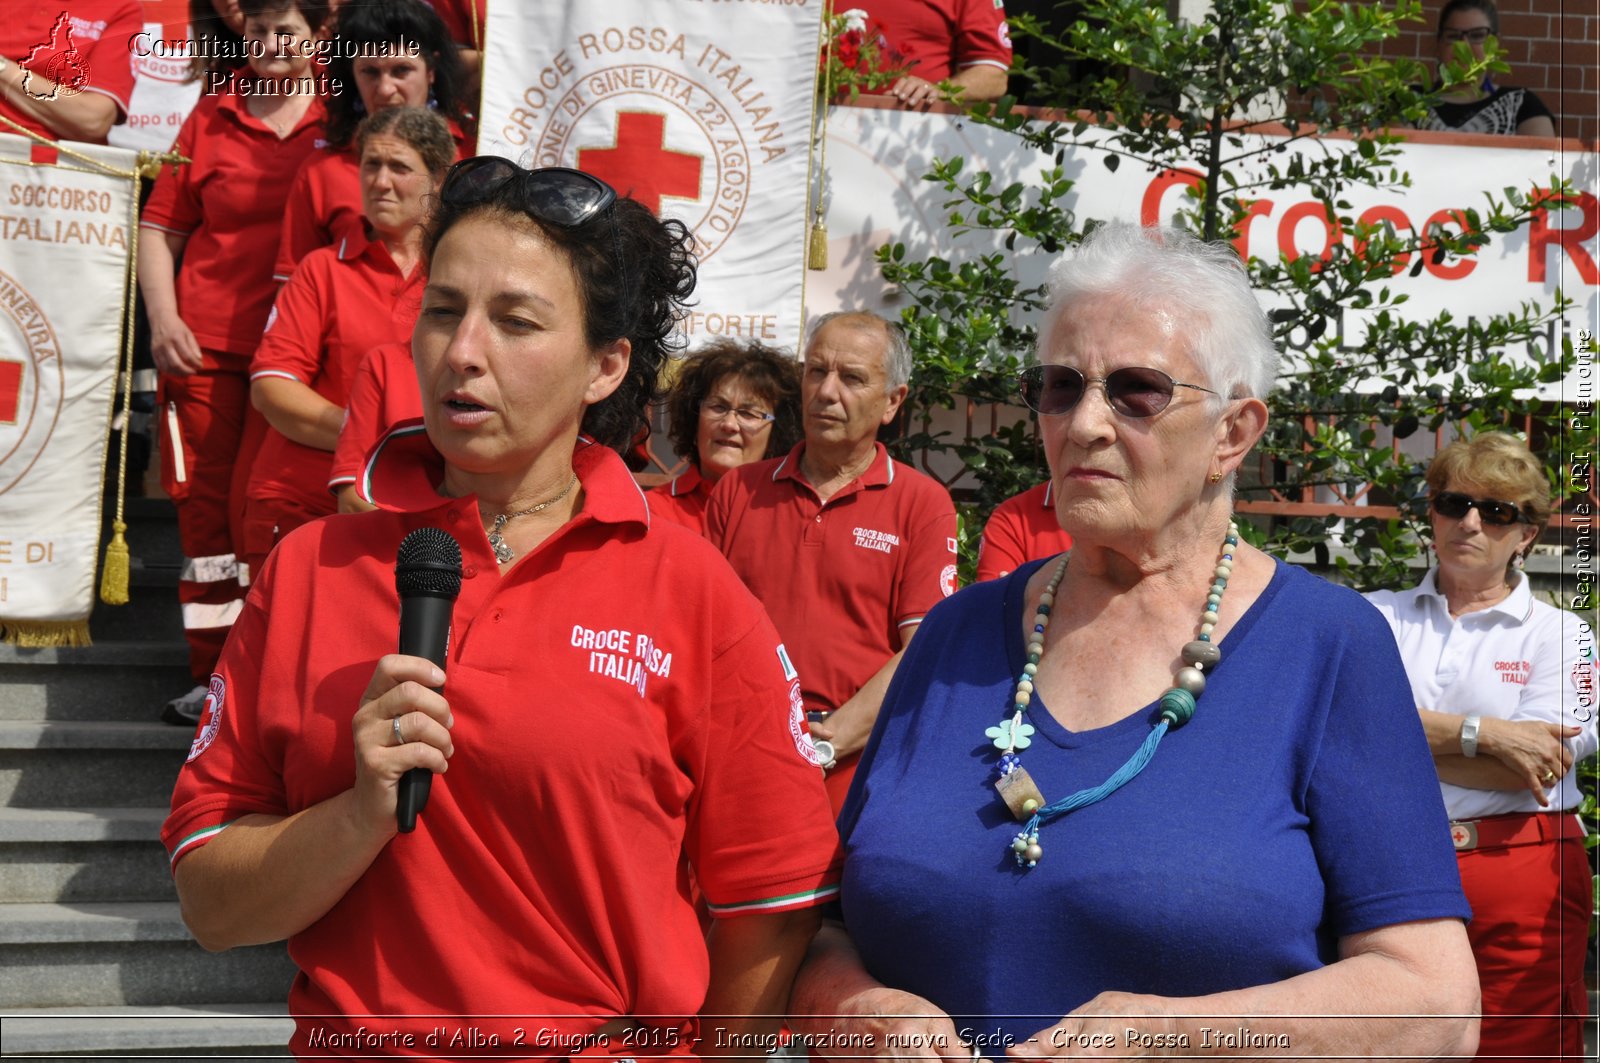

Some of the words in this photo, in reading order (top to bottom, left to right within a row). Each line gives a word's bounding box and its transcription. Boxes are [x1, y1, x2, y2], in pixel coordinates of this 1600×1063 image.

[502, 52, 575, 146] CROCE
[579, 27, 686, 60] ROSSA
[698, 44, 786, 165] ITALIANA
[589, 68, 694, 106] GINEVRA
[166, 112, 183, 127] di
[563, 94, 586, 117] DI
[695, 102, 727, 132] 22
[9, 183, 112, 214] SOCCORSO
[708, 139, 746, 233] AGOSTO
[0, 215, 128, 250] TALIANA
[0, 277, 55, 363] INEVRA
[852, 527, 878, 541] CROCE
[854, 536, 892, 554] ITALIANA
[26, 541, 54, 564] DI
[571, 625, 632, 654] CROCE
[1494, 660, 1521, 671] CROCE
